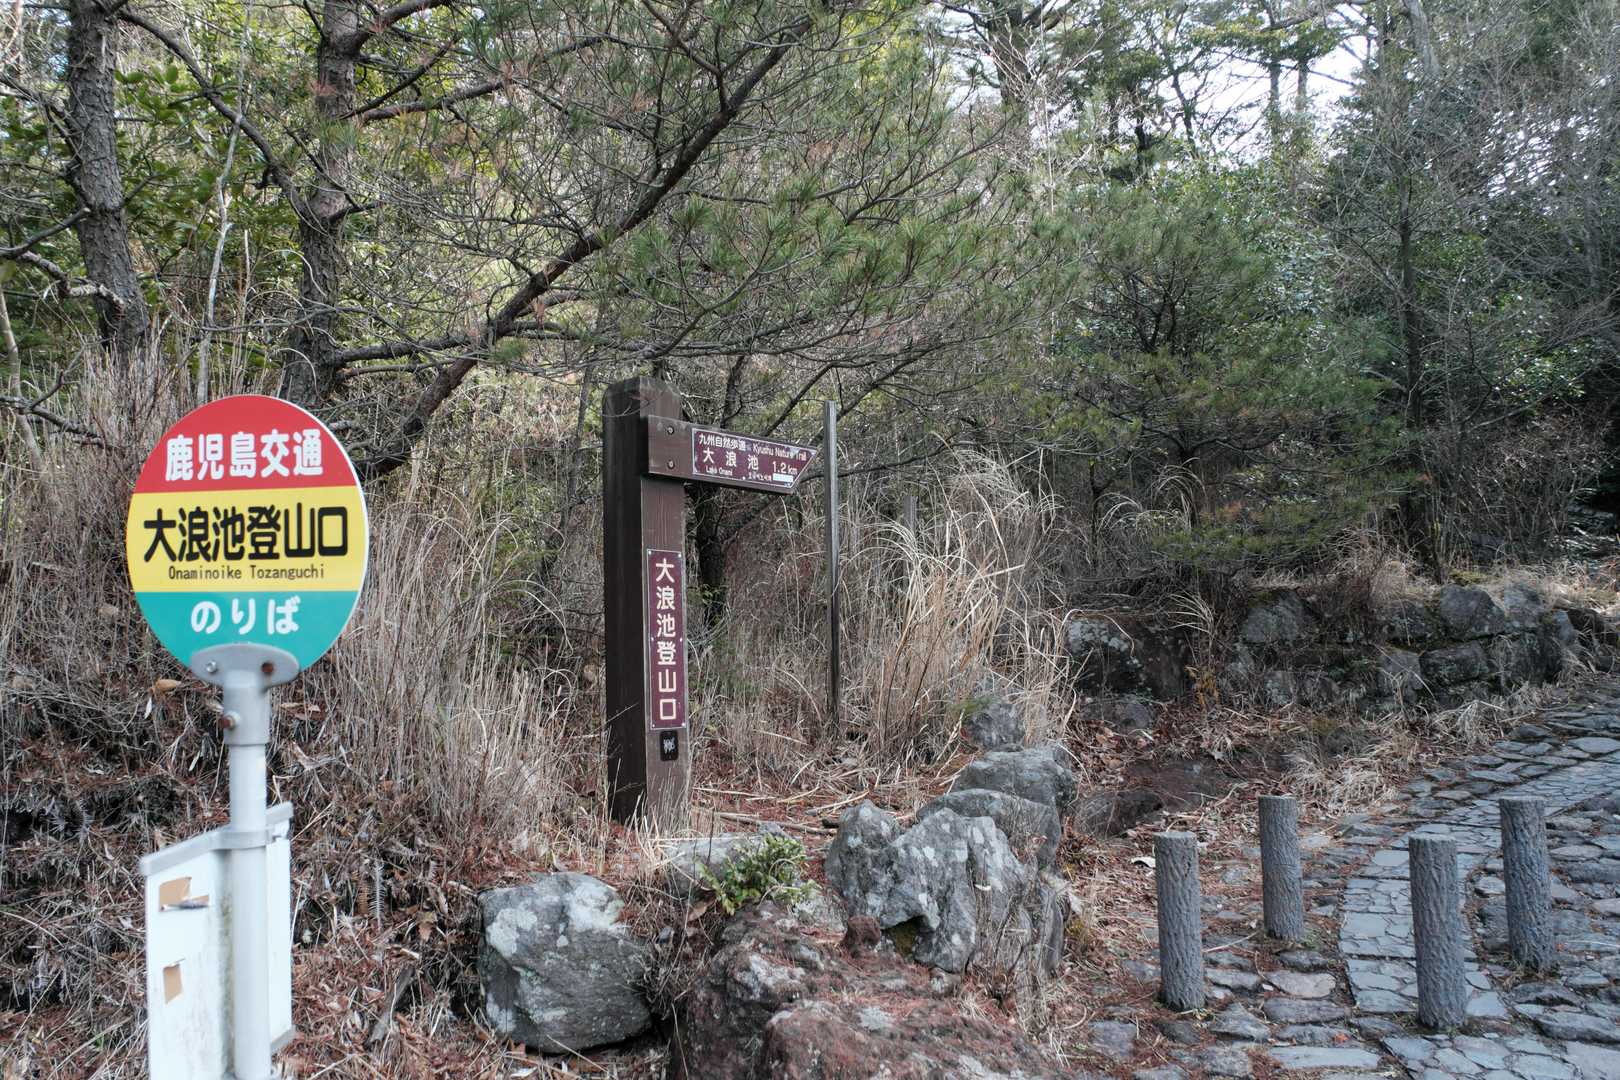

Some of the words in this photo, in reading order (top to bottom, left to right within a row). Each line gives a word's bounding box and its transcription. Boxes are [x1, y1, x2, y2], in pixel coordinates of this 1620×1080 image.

[165, 429, 323, 481] 鹿児島交通
[698, 433, 747, 451] 九州自然歩道
[752, 443, 774, 456] Kyushu
[143, 502, 349, 562] 大浪池登山口
[168, 565, 242, 580] Onaminoike
[250, 564, 325, 580] Tozanguchi
[190, 595, 301, 635] のりば
[655, 557, 677, 721] 大浪池登山口
